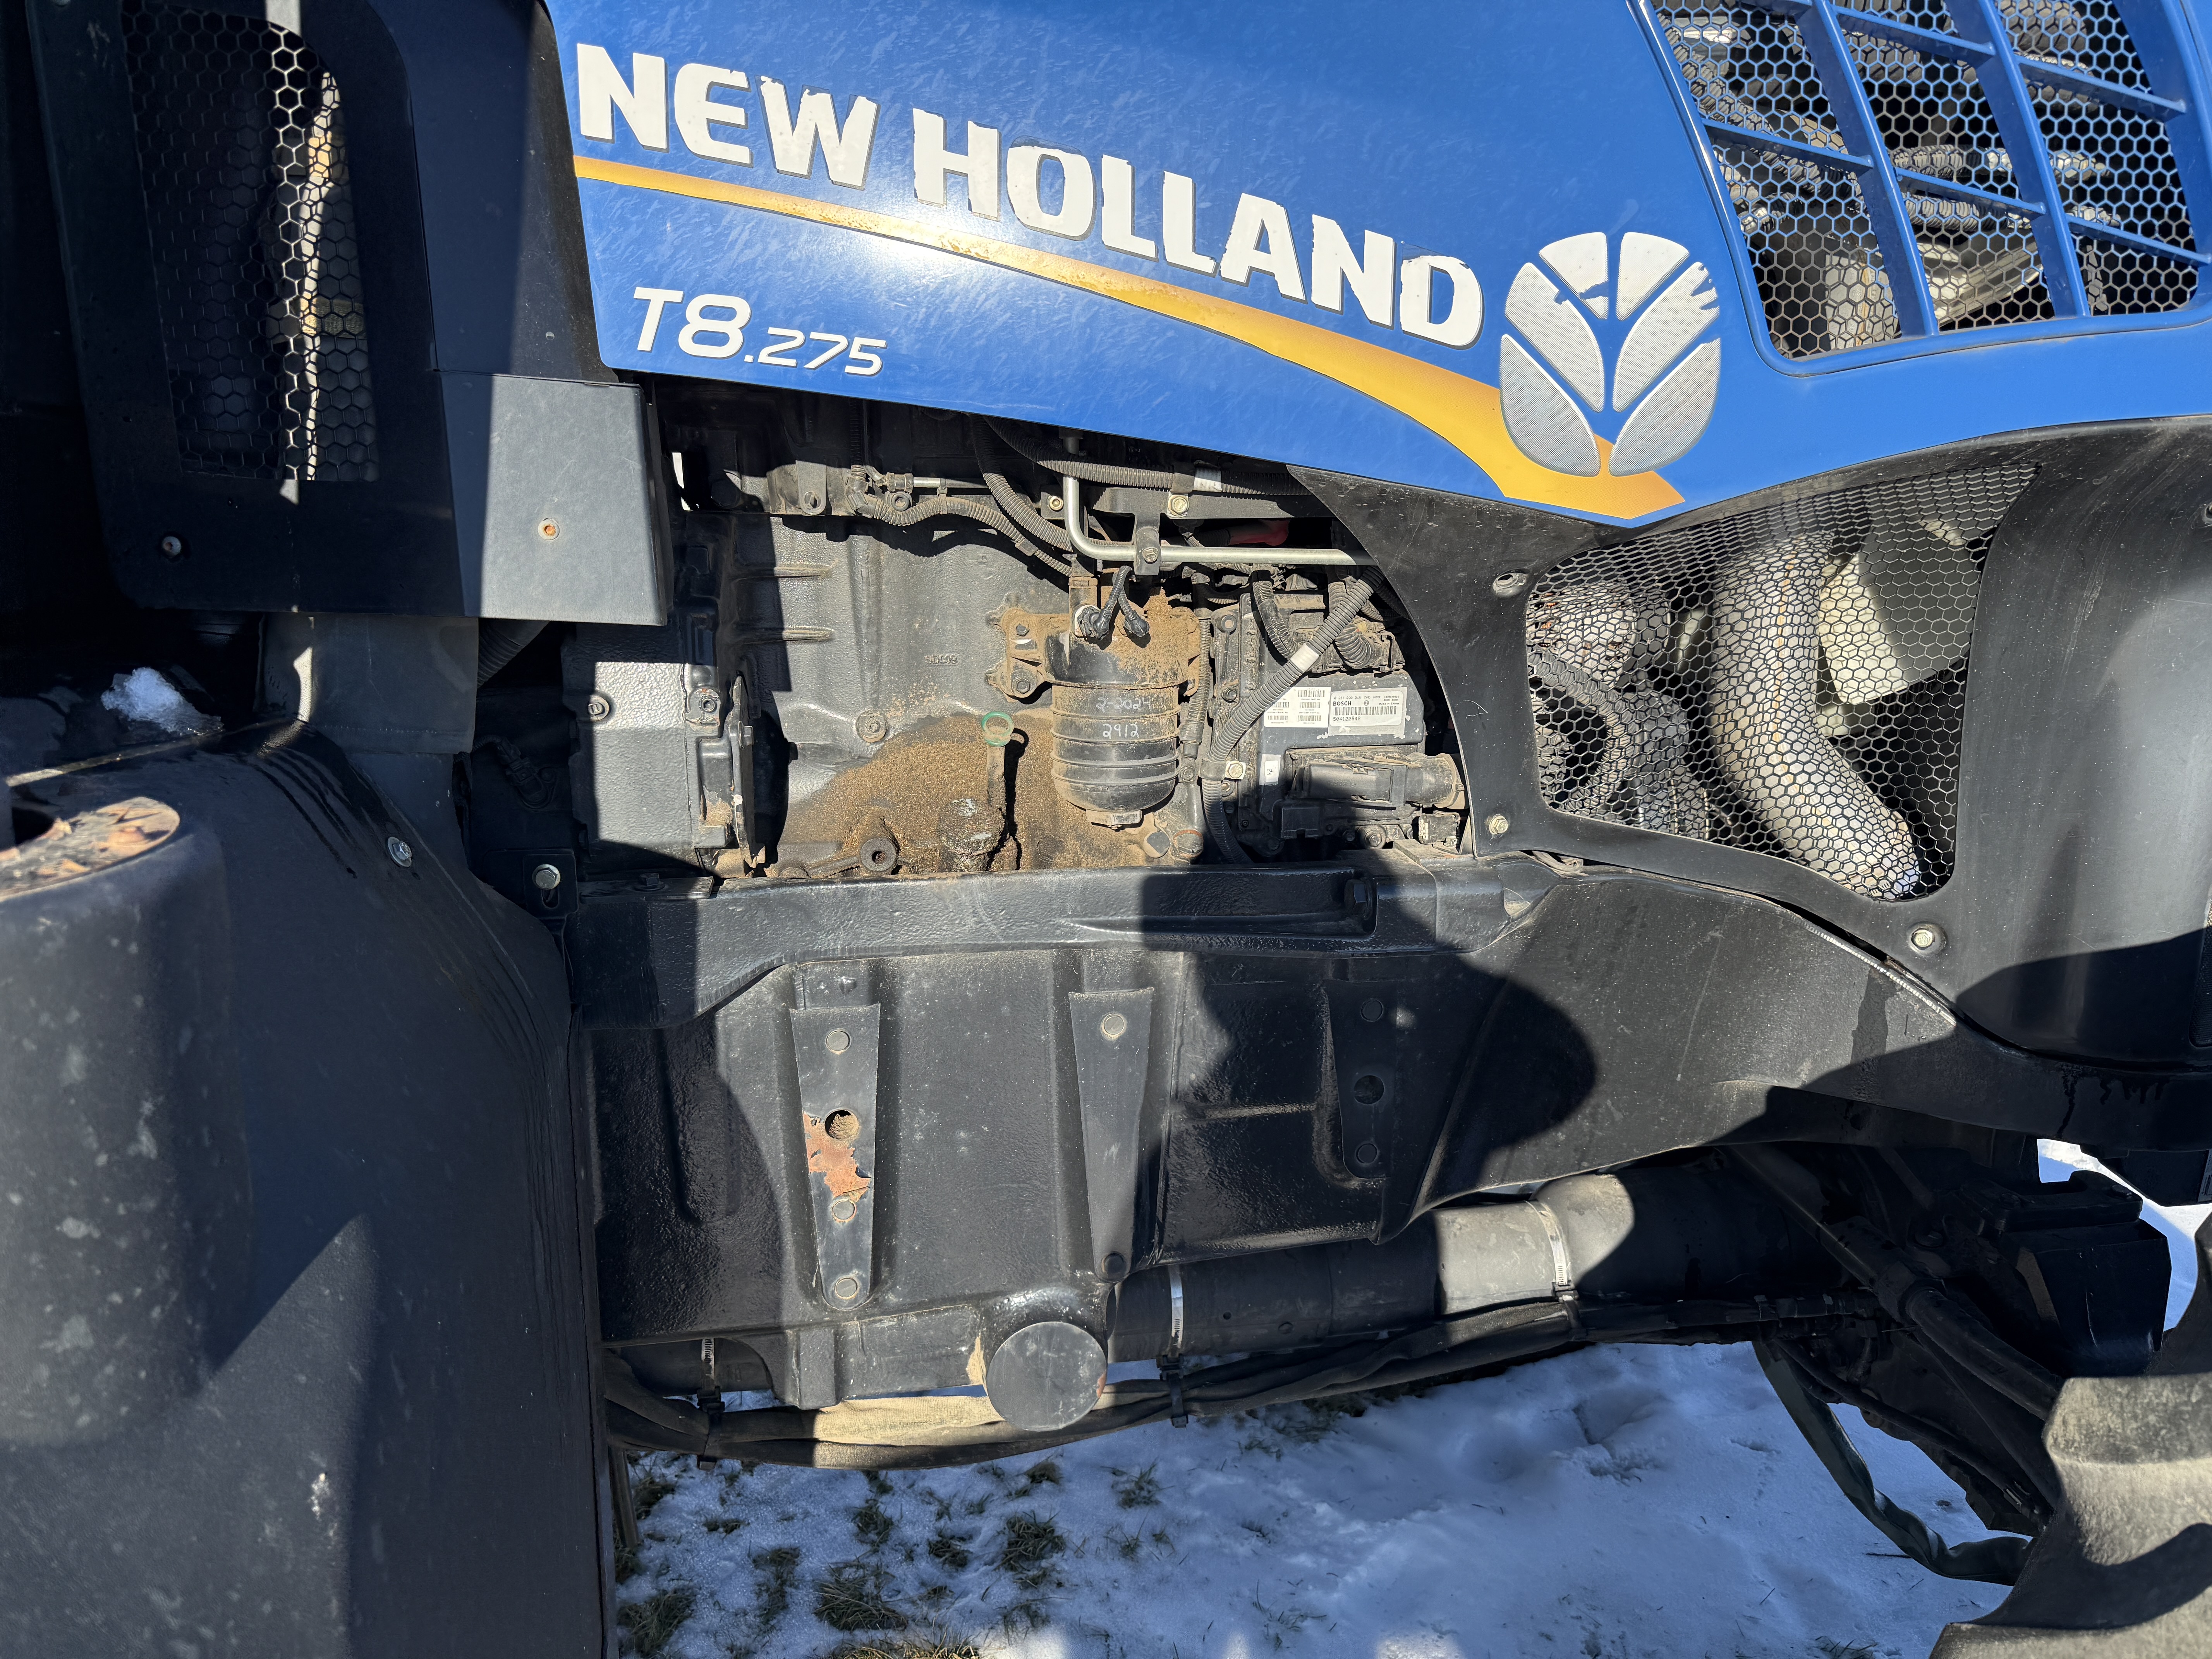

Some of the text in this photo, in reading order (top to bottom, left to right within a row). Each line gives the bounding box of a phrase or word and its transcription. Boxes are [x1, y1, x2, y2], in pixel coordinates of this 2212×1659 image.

[576, 43, 1483, 350] NEW HOLLAND
[633, 286, 888, 376] T8.275
[1103, 723, 1140, 739] 2912
